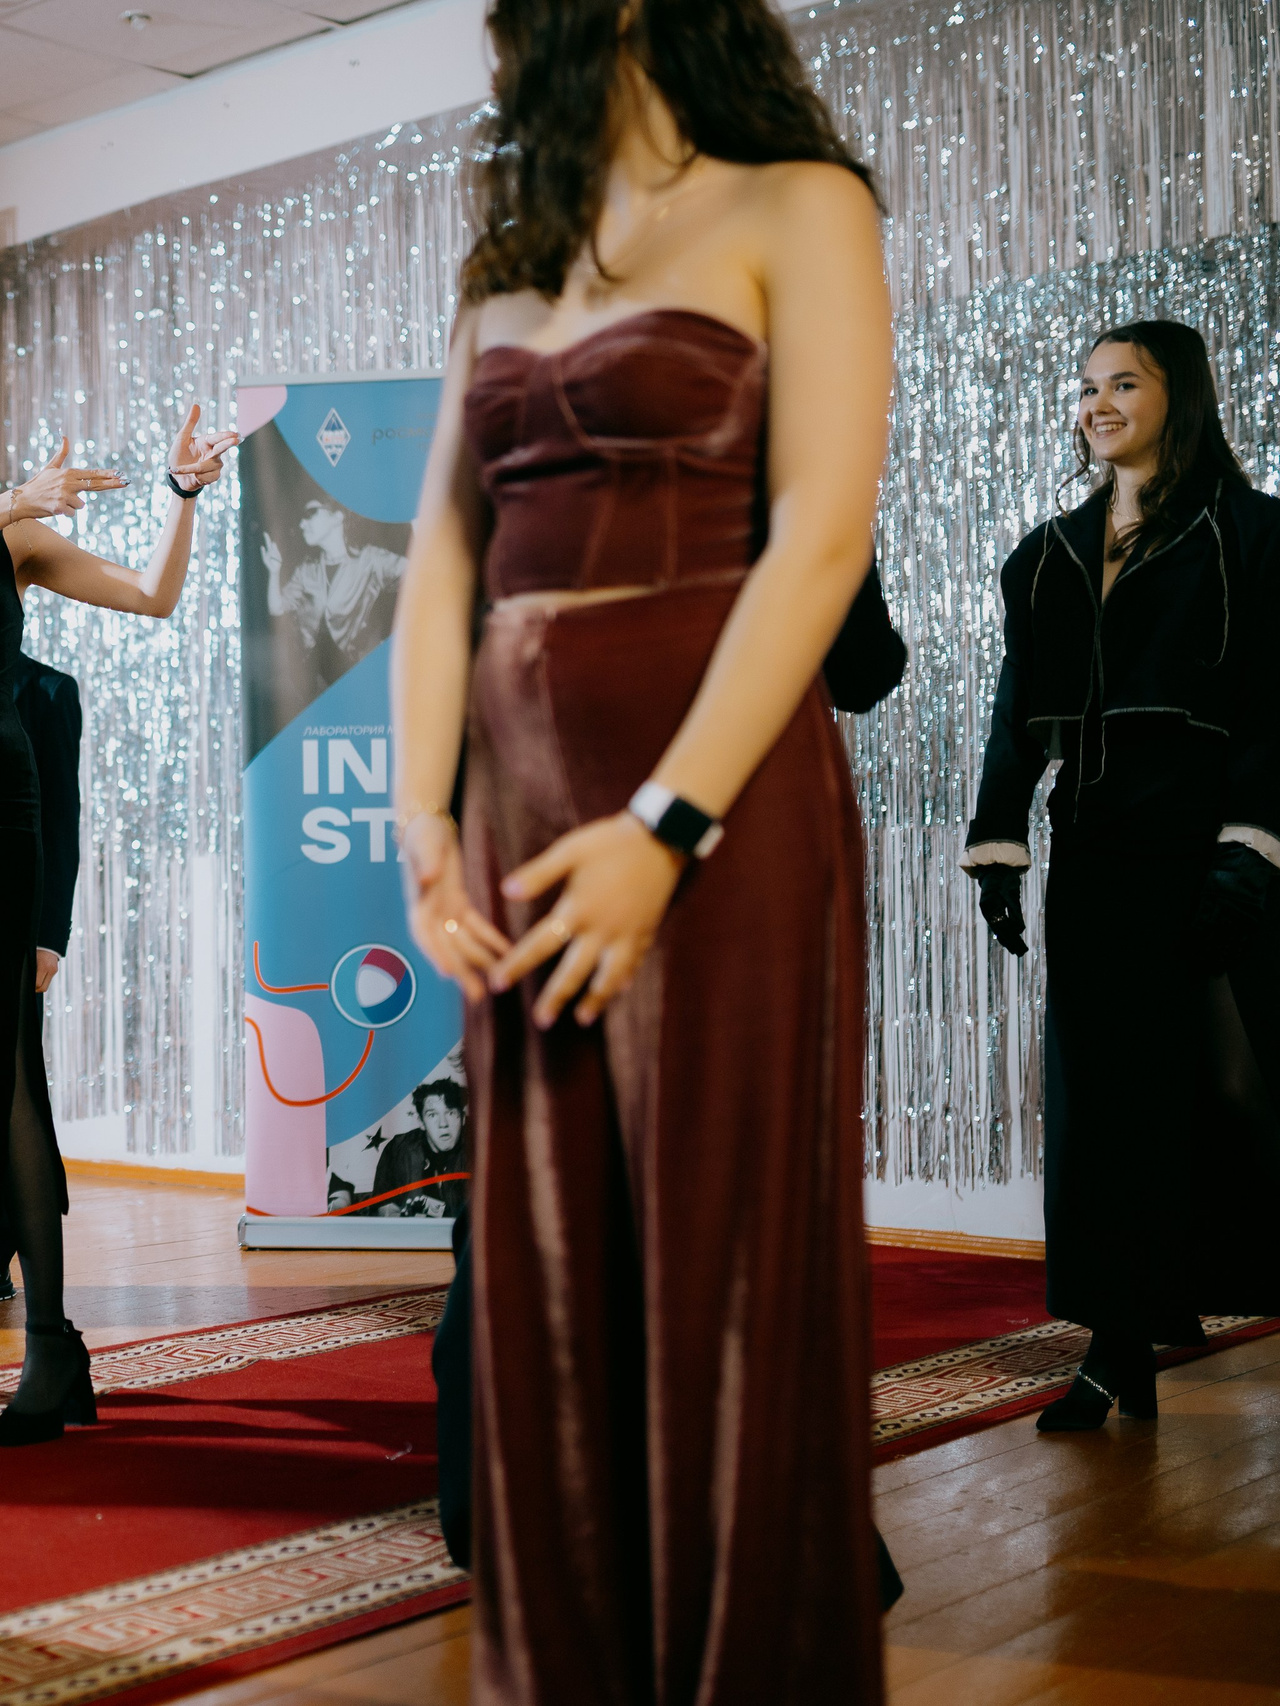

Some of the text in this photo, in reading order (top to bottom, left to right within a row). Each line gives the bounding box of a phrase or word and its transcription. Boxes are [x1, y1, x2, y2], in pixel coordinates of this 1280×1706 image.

[303, 725, 385, 736] ЛАБОРАТОРИЯ
[302, 738, 387, 795] IN
[300, 806, 407, 864] ST
